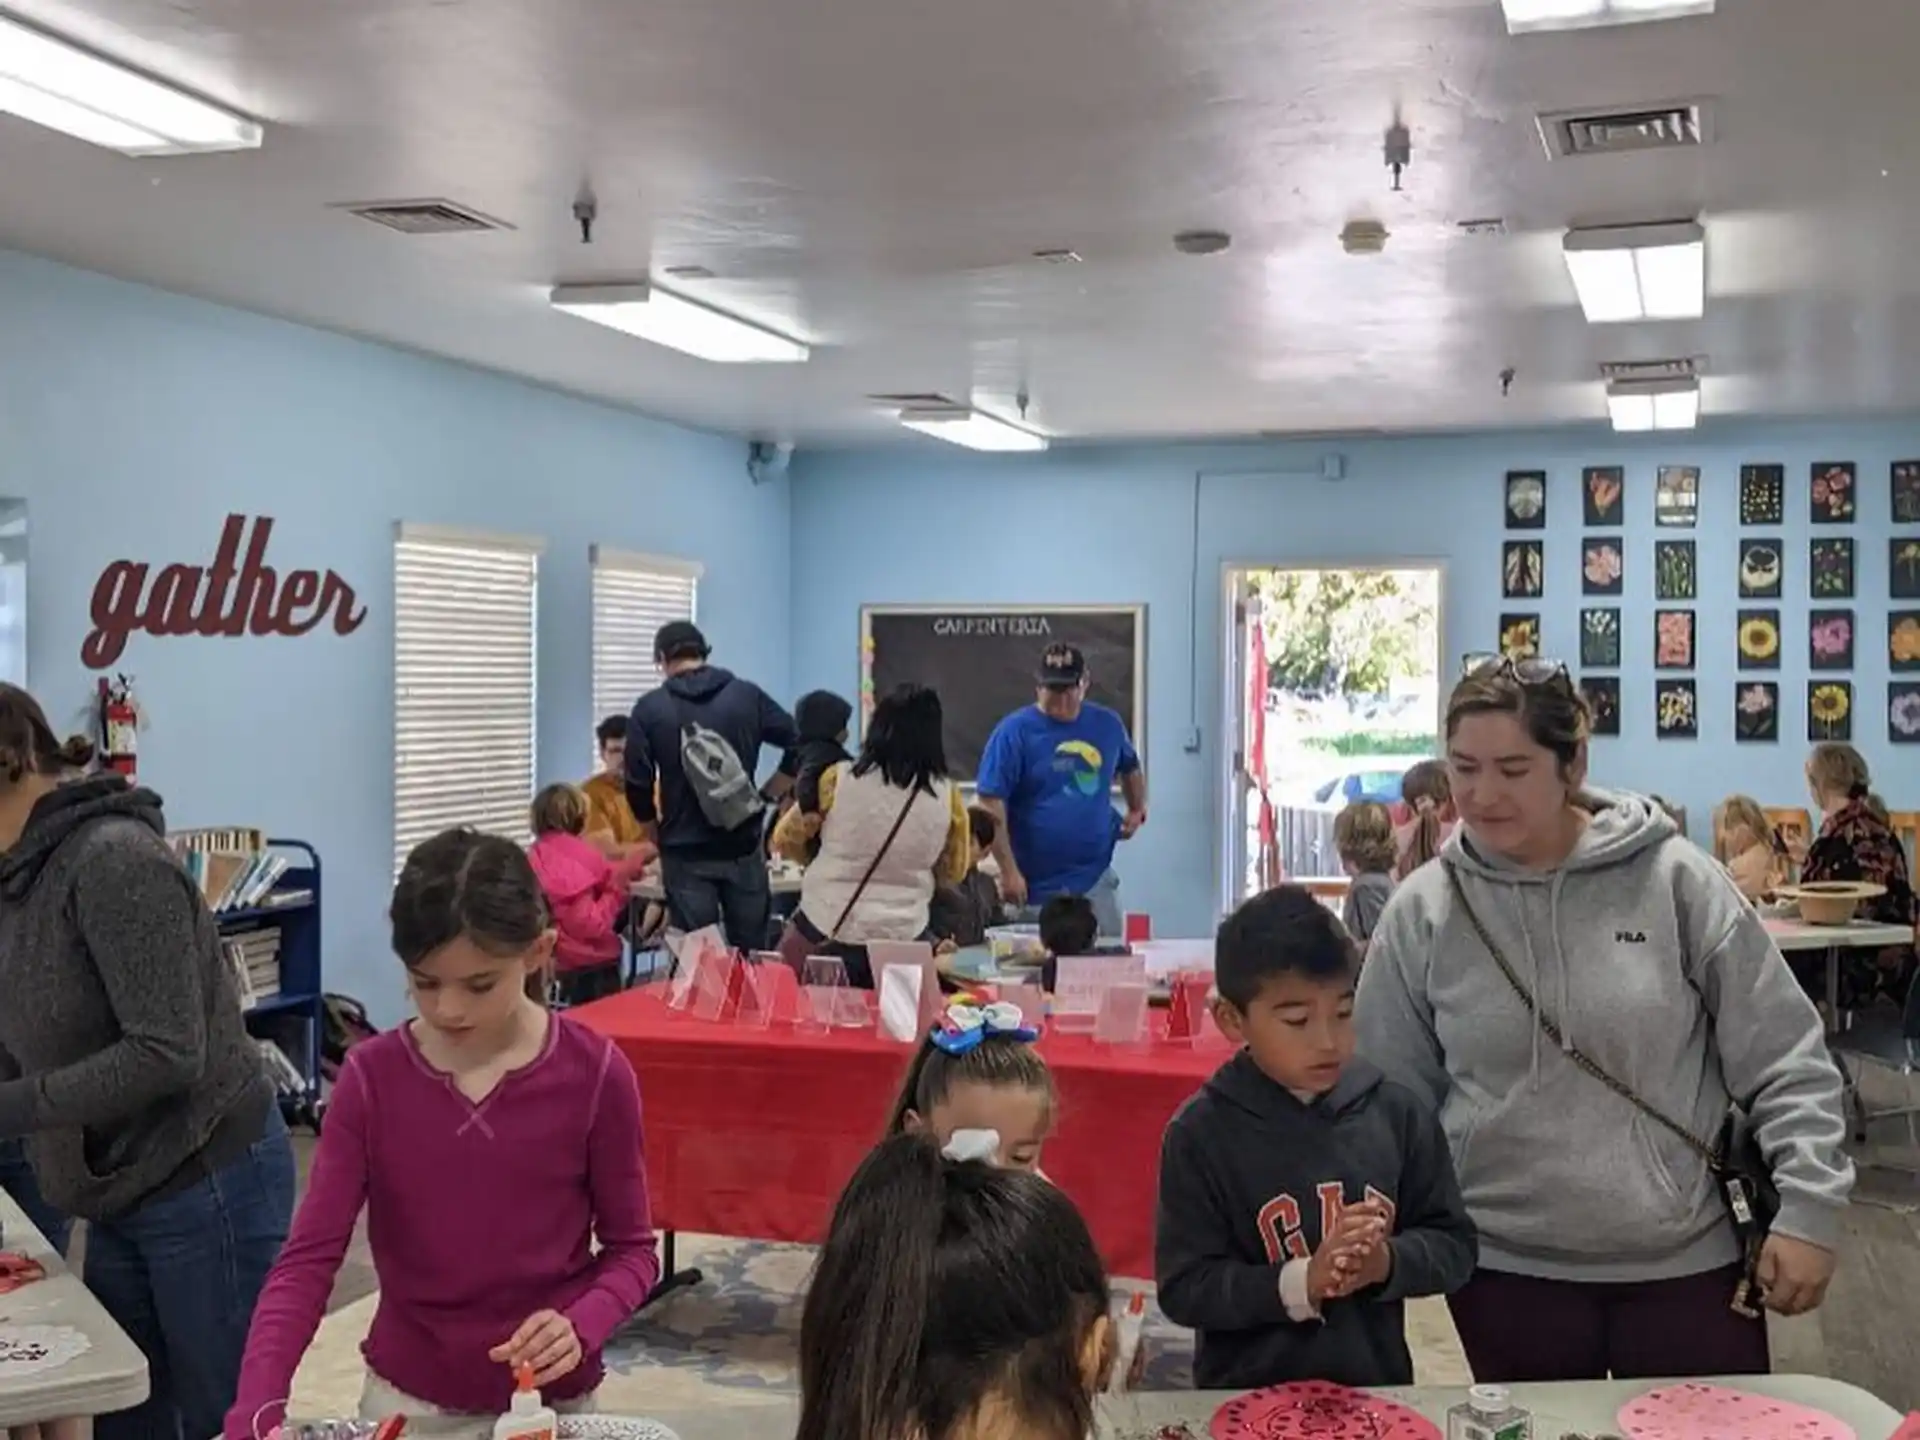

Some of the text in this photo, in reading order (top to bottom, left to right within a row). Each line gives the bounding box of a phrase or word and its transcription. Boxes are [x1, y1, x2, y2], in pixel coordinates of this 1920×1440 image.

[80, 512, 367, 670] gather
[933, 616, 1052, 635] CARPINTERIA
[1615, 931, 1646, 943] FILA
